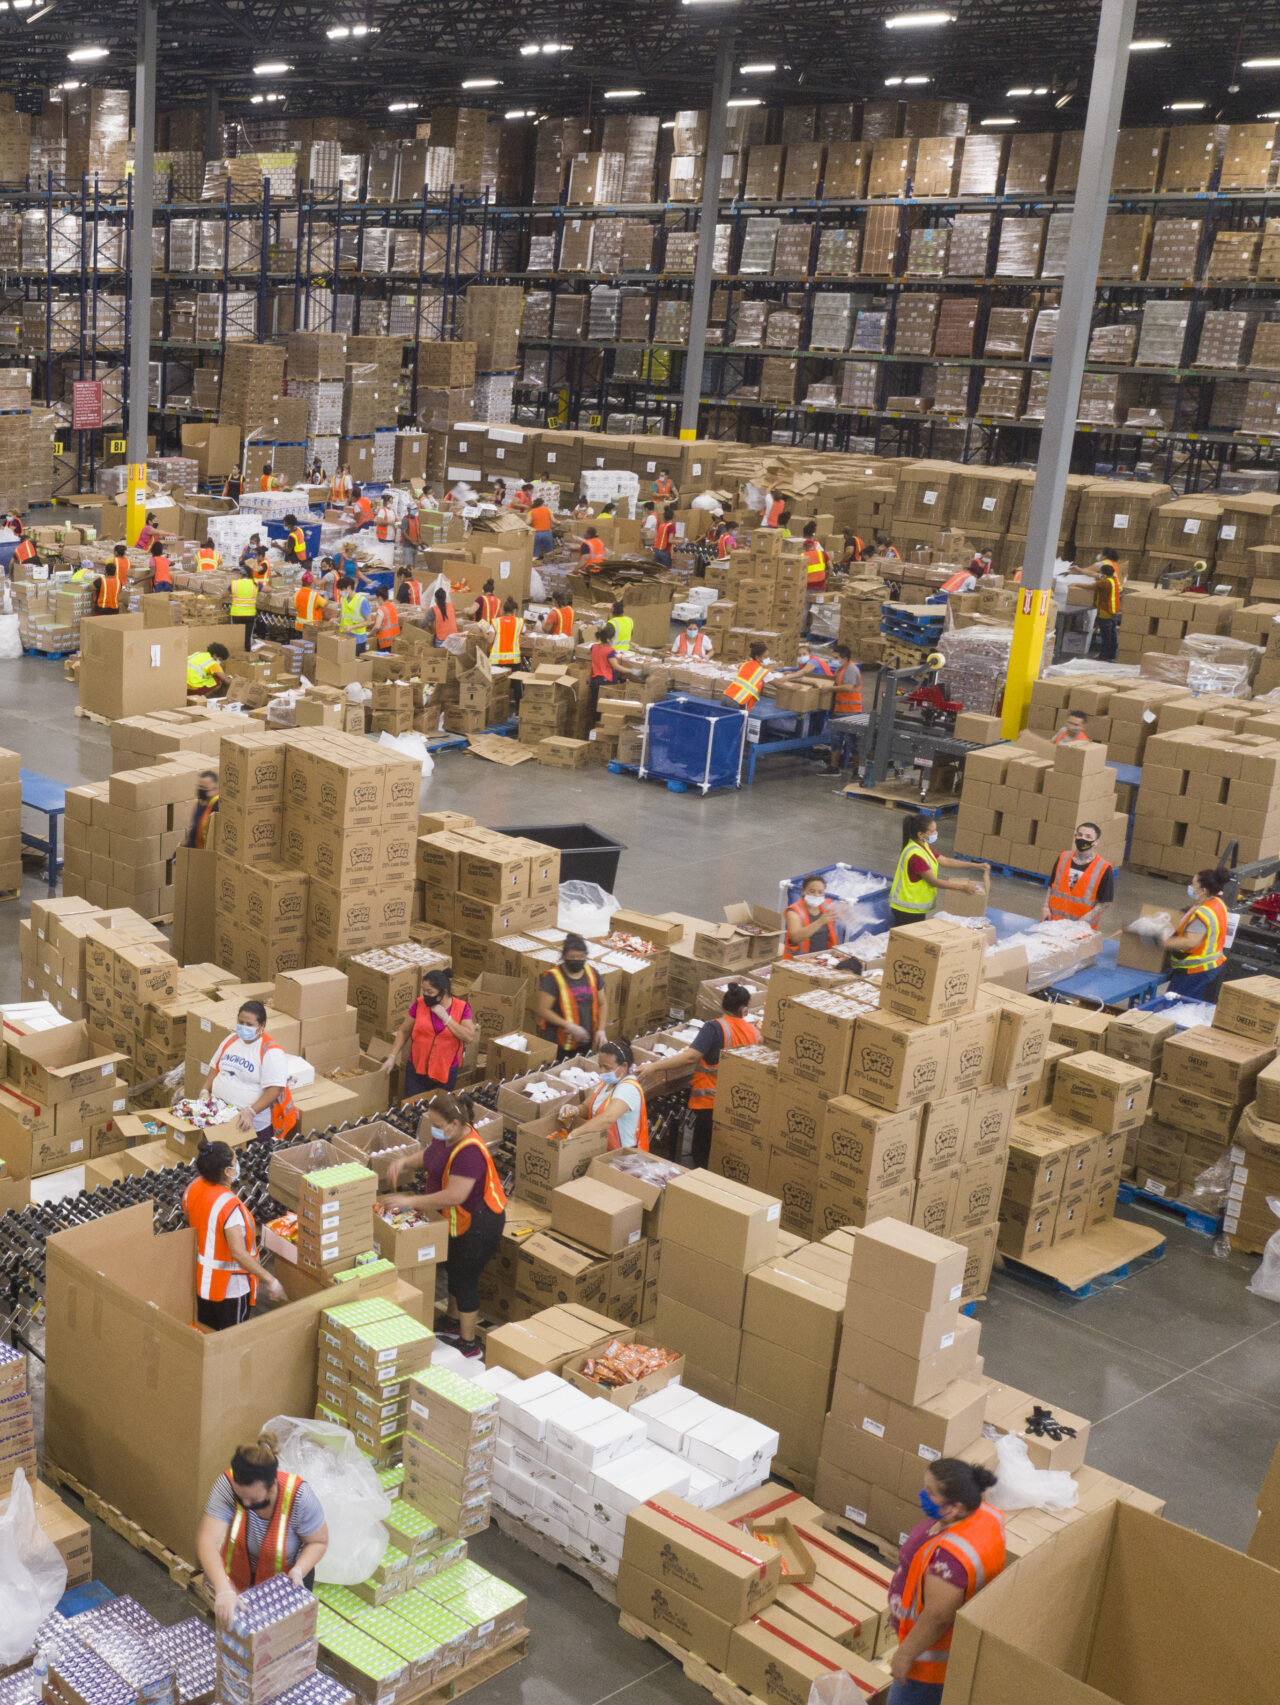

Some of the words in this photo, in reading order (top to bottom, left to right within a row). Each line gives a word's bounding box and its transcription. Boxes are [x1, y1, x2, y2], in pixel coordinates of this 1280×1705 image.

[893, 960, 926, 979] Cocoa
[894, 972, 925, 990] Puffs
[945, 973, 969, 988] Cocoa
[898, 985, 910, 997] Less
[910, 988, 926, 1002] Sugar
[945, 982, 968, 1000] Puffs
[794, 1035, 825, 1052] Cocoa
[223, 1054, 254, 1072] NGWOOD
[796, 1047, 824, 1064] Puffs
[861, 1048, 894, 1066] Cocoa
[862, 1060, 892, 1078] Puffs
[1162, 1072, 1168, 1080] 3
[866, 1074, 878, 1084] Less
[879, 1078, 894, 1090] Sugar
[731, 1085, 760, 1102] Cocoa
[732, 1096, 760, 1113] Puffs
[786, 1110, 816, 1126] Cocoa
[788, 1122, 816, 1139] Puffs
[832, 1132, 863, 1150] Cocoa
[524, 1152, 550, 1167] Cocoa
[833, 1144, 862, 1162] Puffs
[526, 1164, 550, 1180] Puffs
[837, 1157, 848, 1168] Less
[848, 1161, 864, 1175] Sugar
[782, 1183, 812, 1200] Cocoa
[784, 1194, 812, 1212] Puffs
